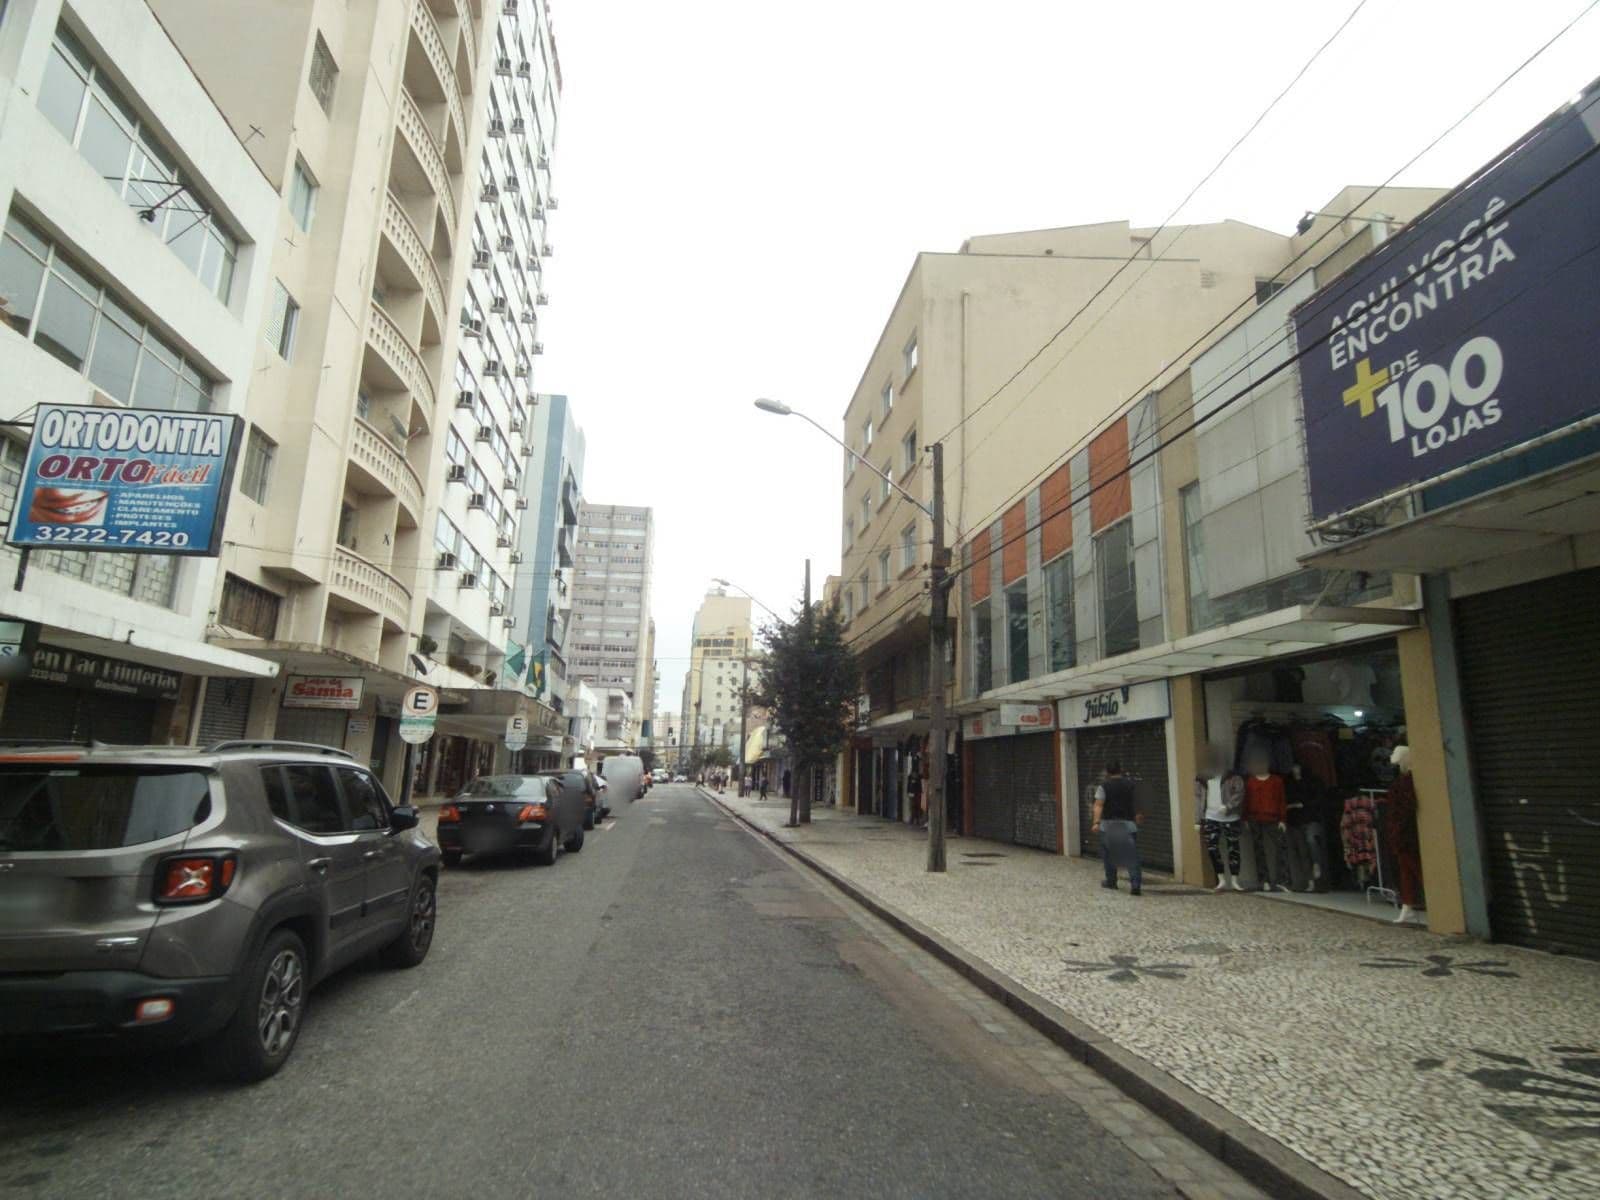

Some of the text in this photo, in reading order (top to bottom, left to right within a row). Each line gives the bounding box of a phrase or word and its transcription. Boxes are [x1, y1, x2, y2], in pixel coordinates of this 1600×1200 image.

[1329, 196, 1510, 344] AQUI VOCÊ
[1330, 237, 1517, 371] ENCONTRA
[1389, 349, 1421, 382] DE
[1376, 336, 1504, 443] 100
[41, 409, 222, 457] ORTODONTIA
[1411, 399, 1503, 458] LOJAS
[118, 499, 201, 509] MANUTENÇÕES
[120, 491, 185, 501] APARELHOS
[114, 520, 177, 528] IMPLANTES
[117, 506, 199, 516] CLAREAMENTO
[35, 525, 189, 547] 3222-7420
[413, 691, 429, 710] E
[1083, 691, 1119, 724] Júbilo
[513, 718, 523, 730] E
